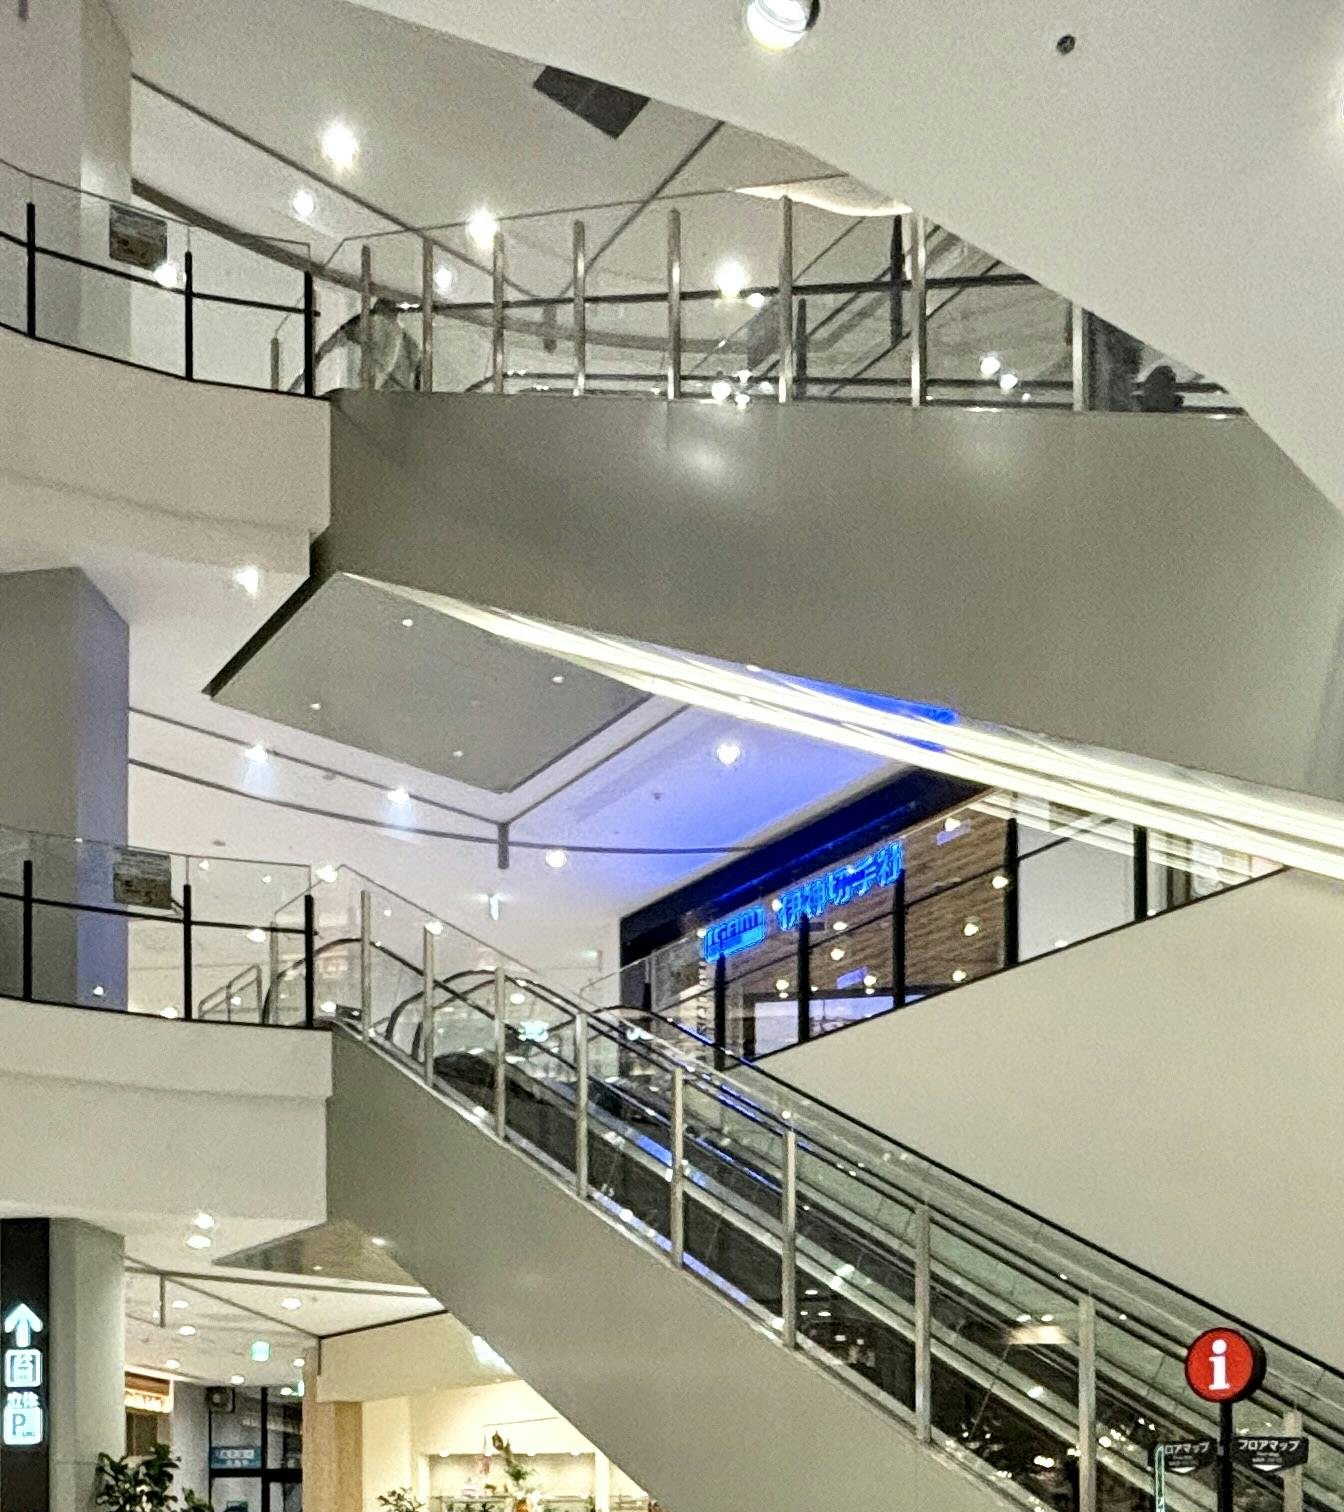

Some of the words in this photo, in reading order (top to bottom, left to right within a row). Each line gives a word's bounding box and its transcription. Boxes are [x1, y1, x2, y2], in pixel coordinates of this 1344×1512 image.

[1165, 1442, 1210, 1455] ロアマップ
[1238, 1439, 1301, 1452] フロアマップ
